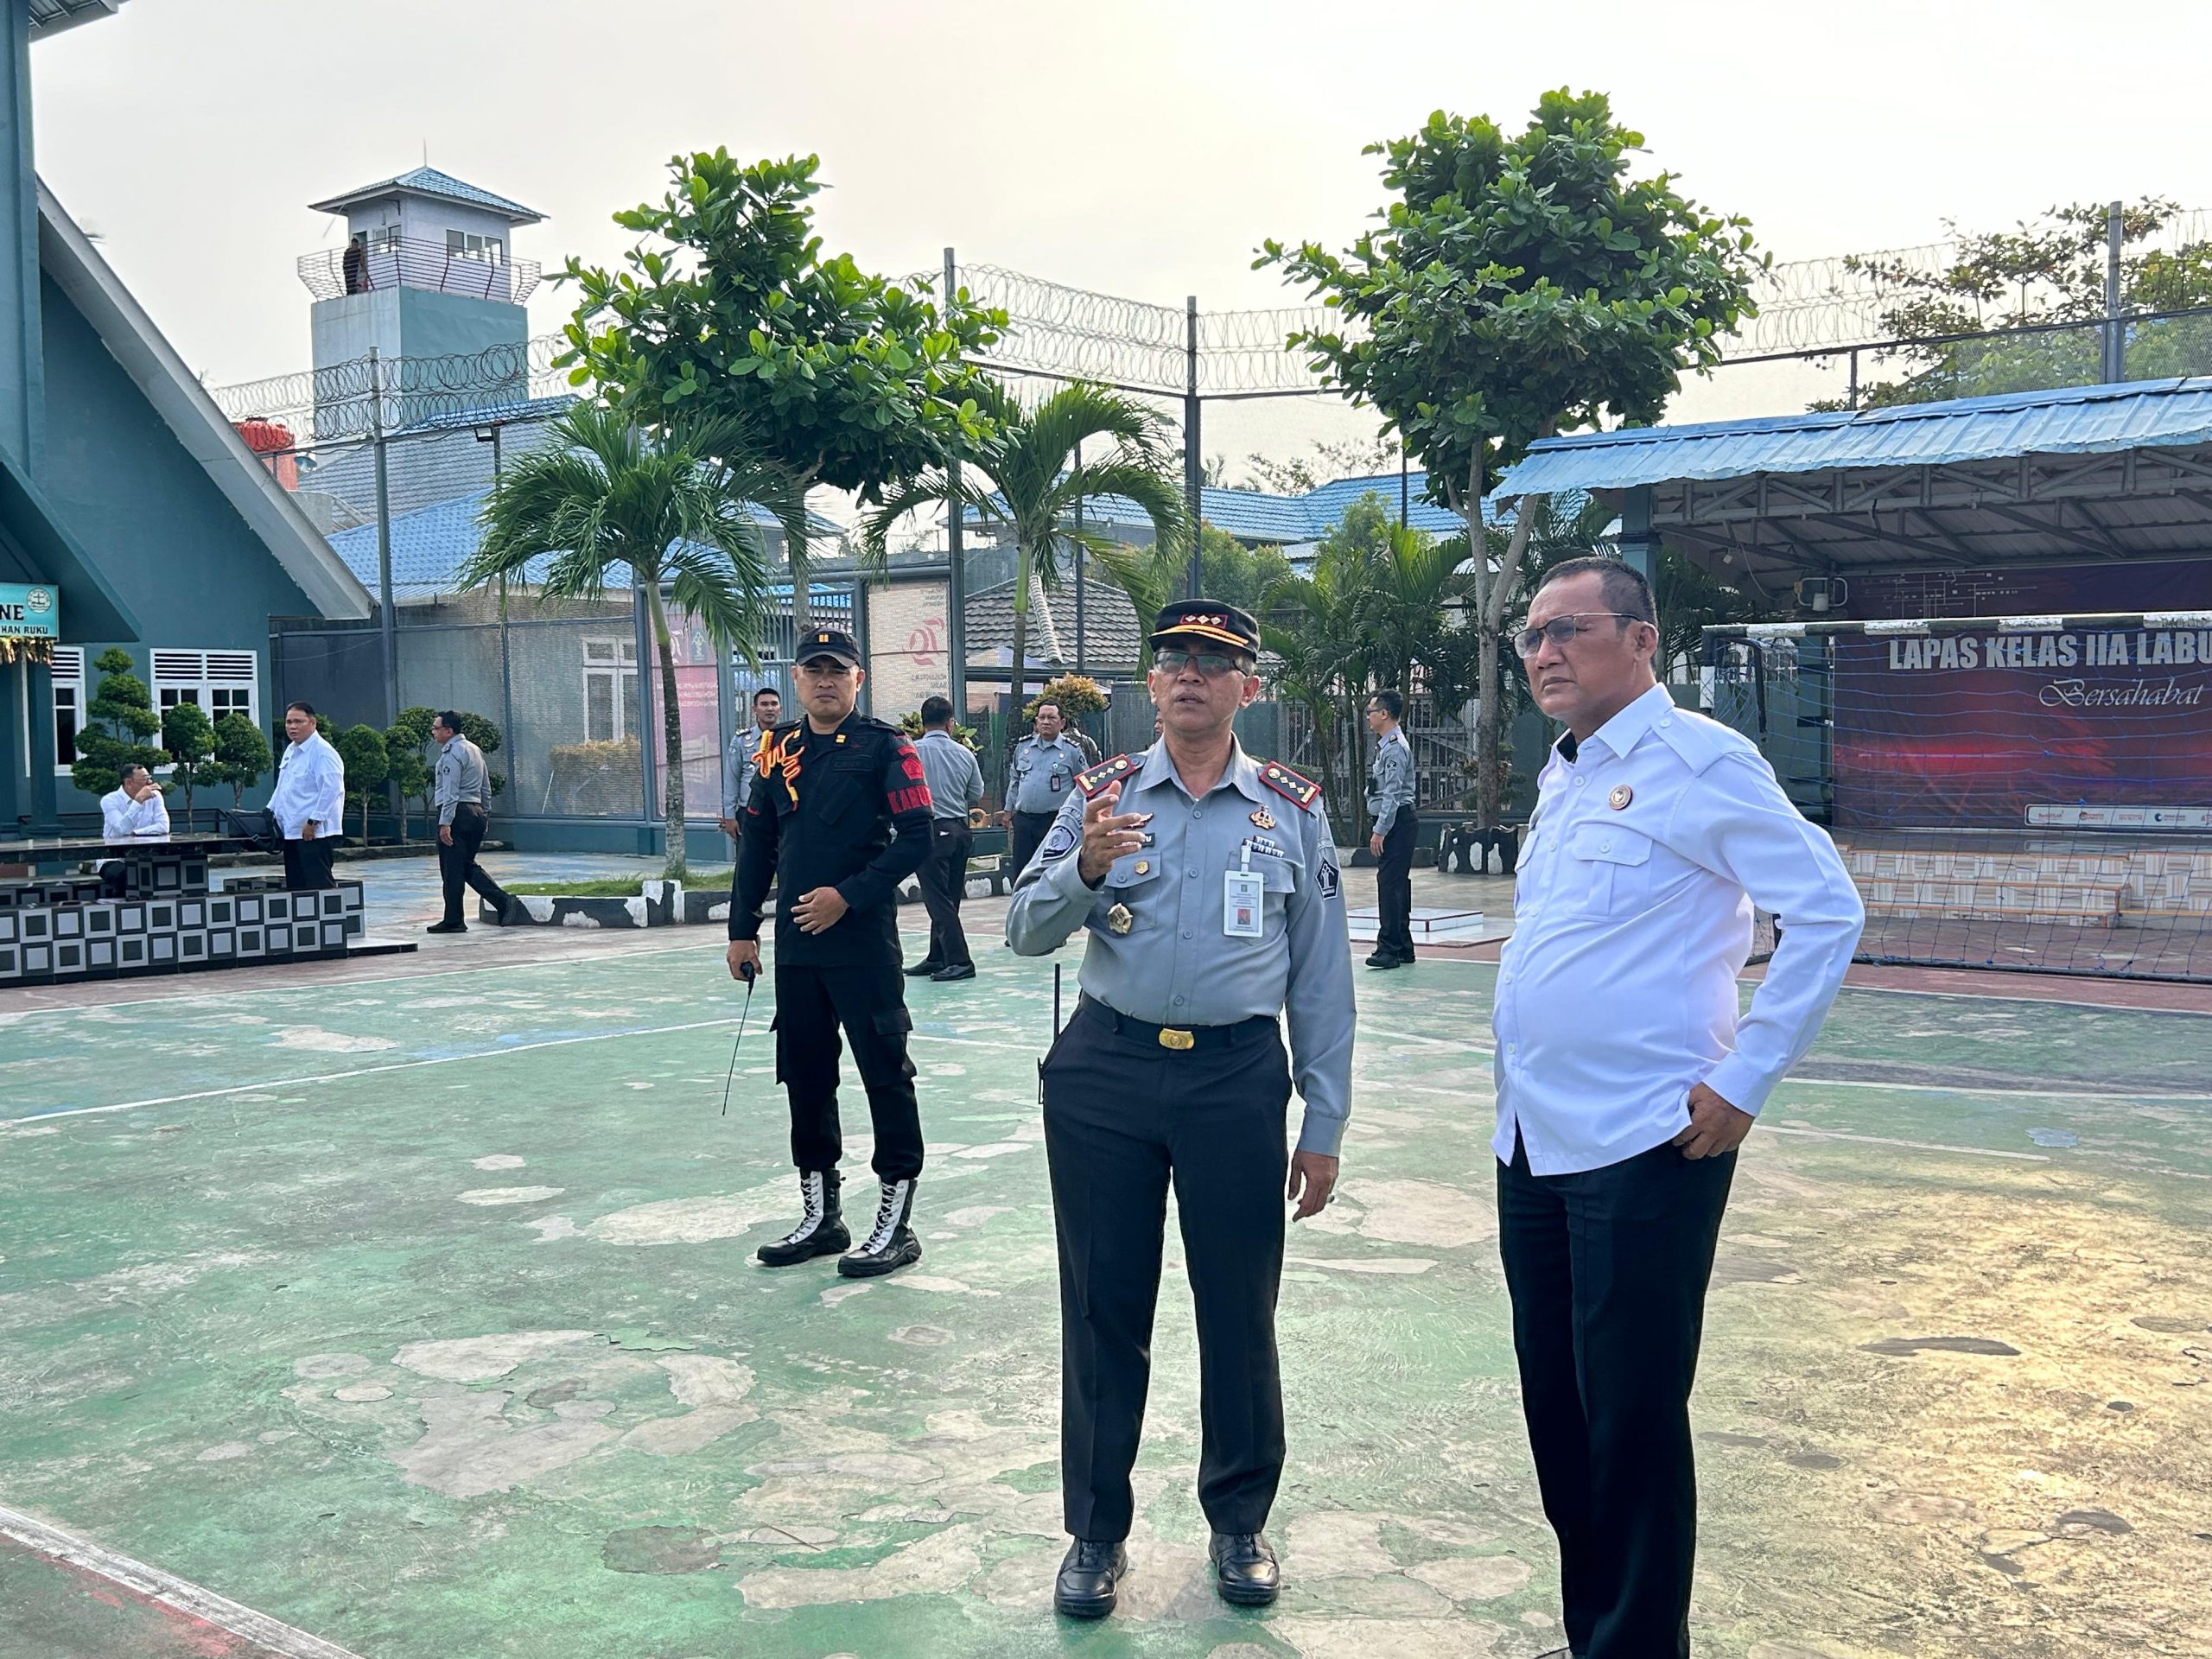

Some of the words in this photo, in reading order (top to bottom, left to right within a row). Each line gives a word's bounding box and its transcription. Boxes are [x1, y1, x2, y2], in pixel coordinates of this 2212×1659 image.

[1, 625, 21, 634] HAN
[23, 626, 48, 635] RUKU
[1889, 637, 1979, 670] LAPAS
[1986, 634, 2077, 668] KELAS
[2085, 633, 2129, 666] IIA
[2136, 631, 2212, 664] LABU
[2038, 677, 2203, 707] Bersahabat
